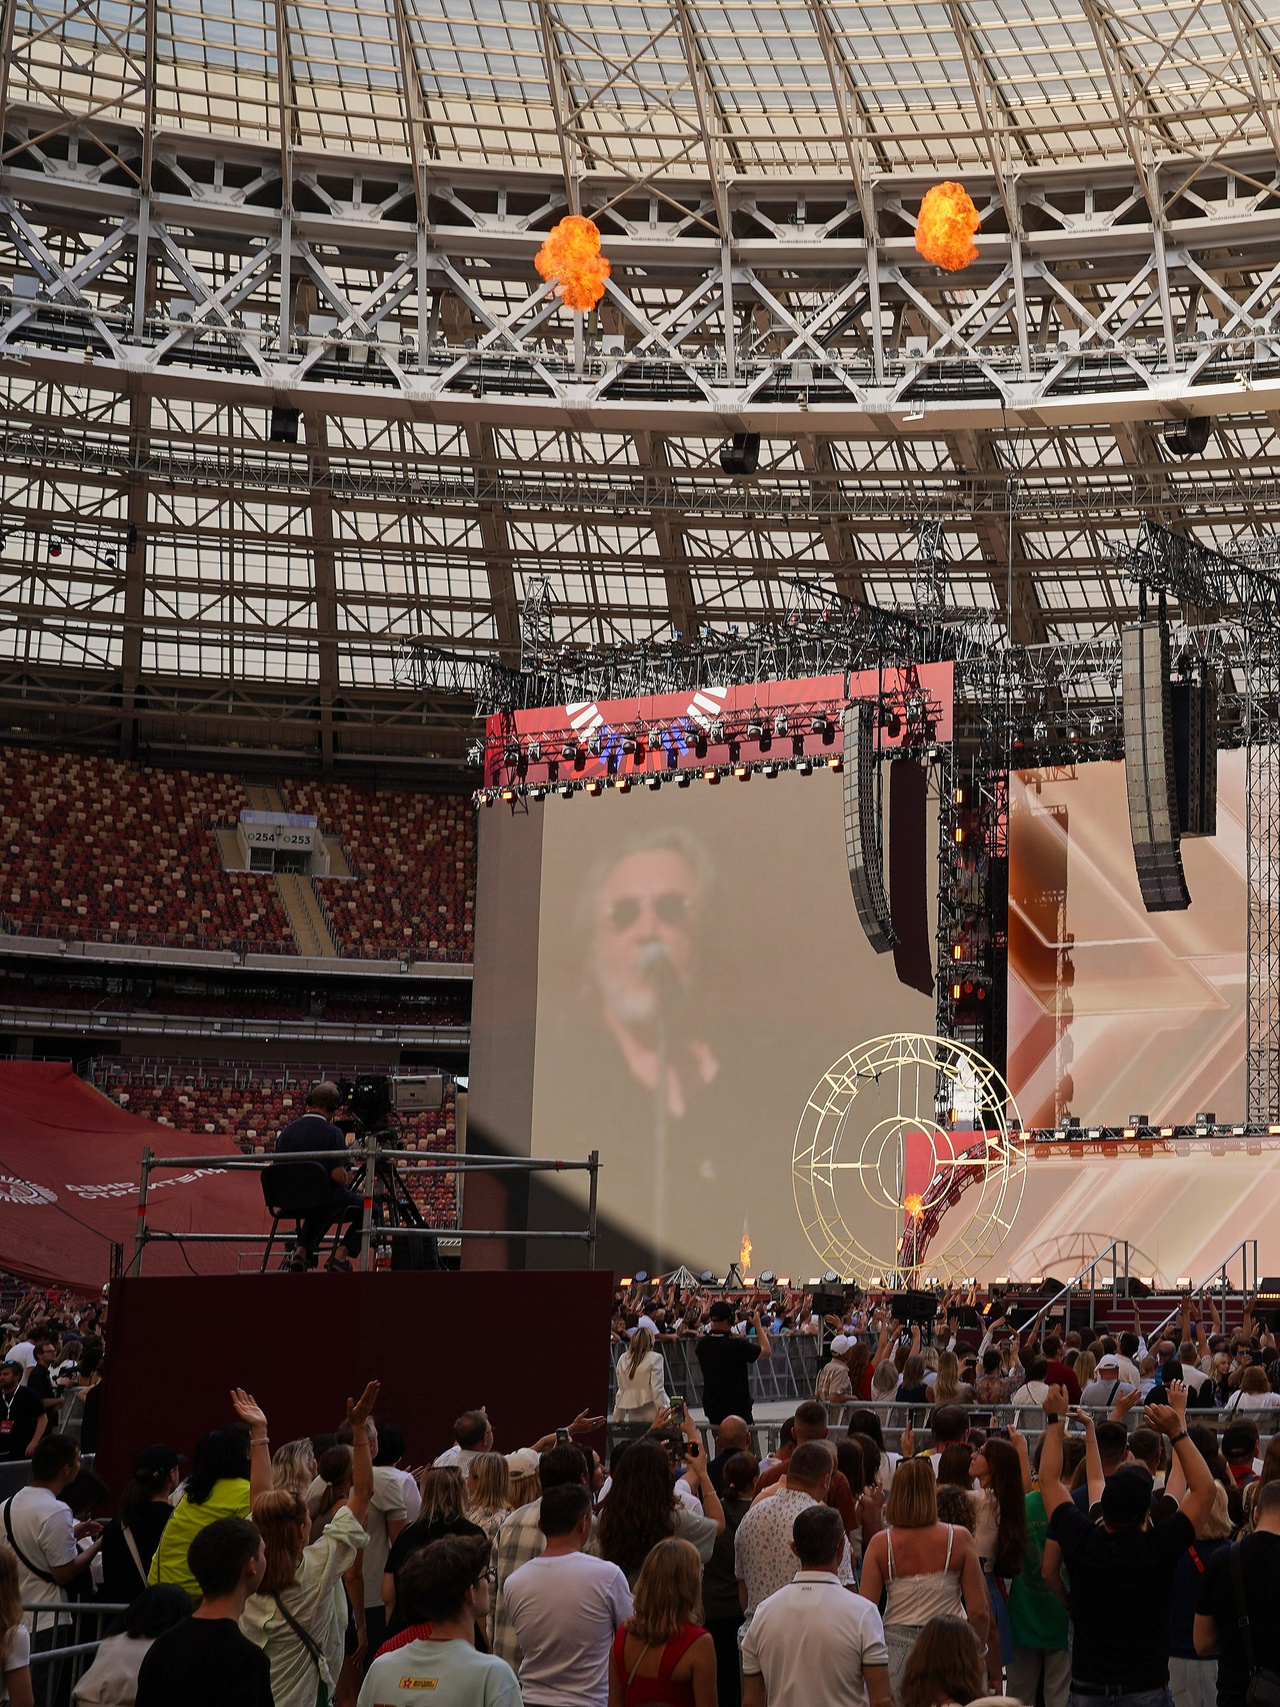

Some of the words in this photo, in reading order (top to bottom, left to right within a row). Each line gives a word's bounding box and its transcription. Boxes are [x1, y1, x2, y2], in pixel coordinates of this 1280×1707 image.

[255, 832, 276, 843] 254
[291, 835, 311, 845] 253
[65, 1181, 135, 1192] ДЕНЬ
[78, 1167, 228, 1200] СТРОИТЕЛЯ
